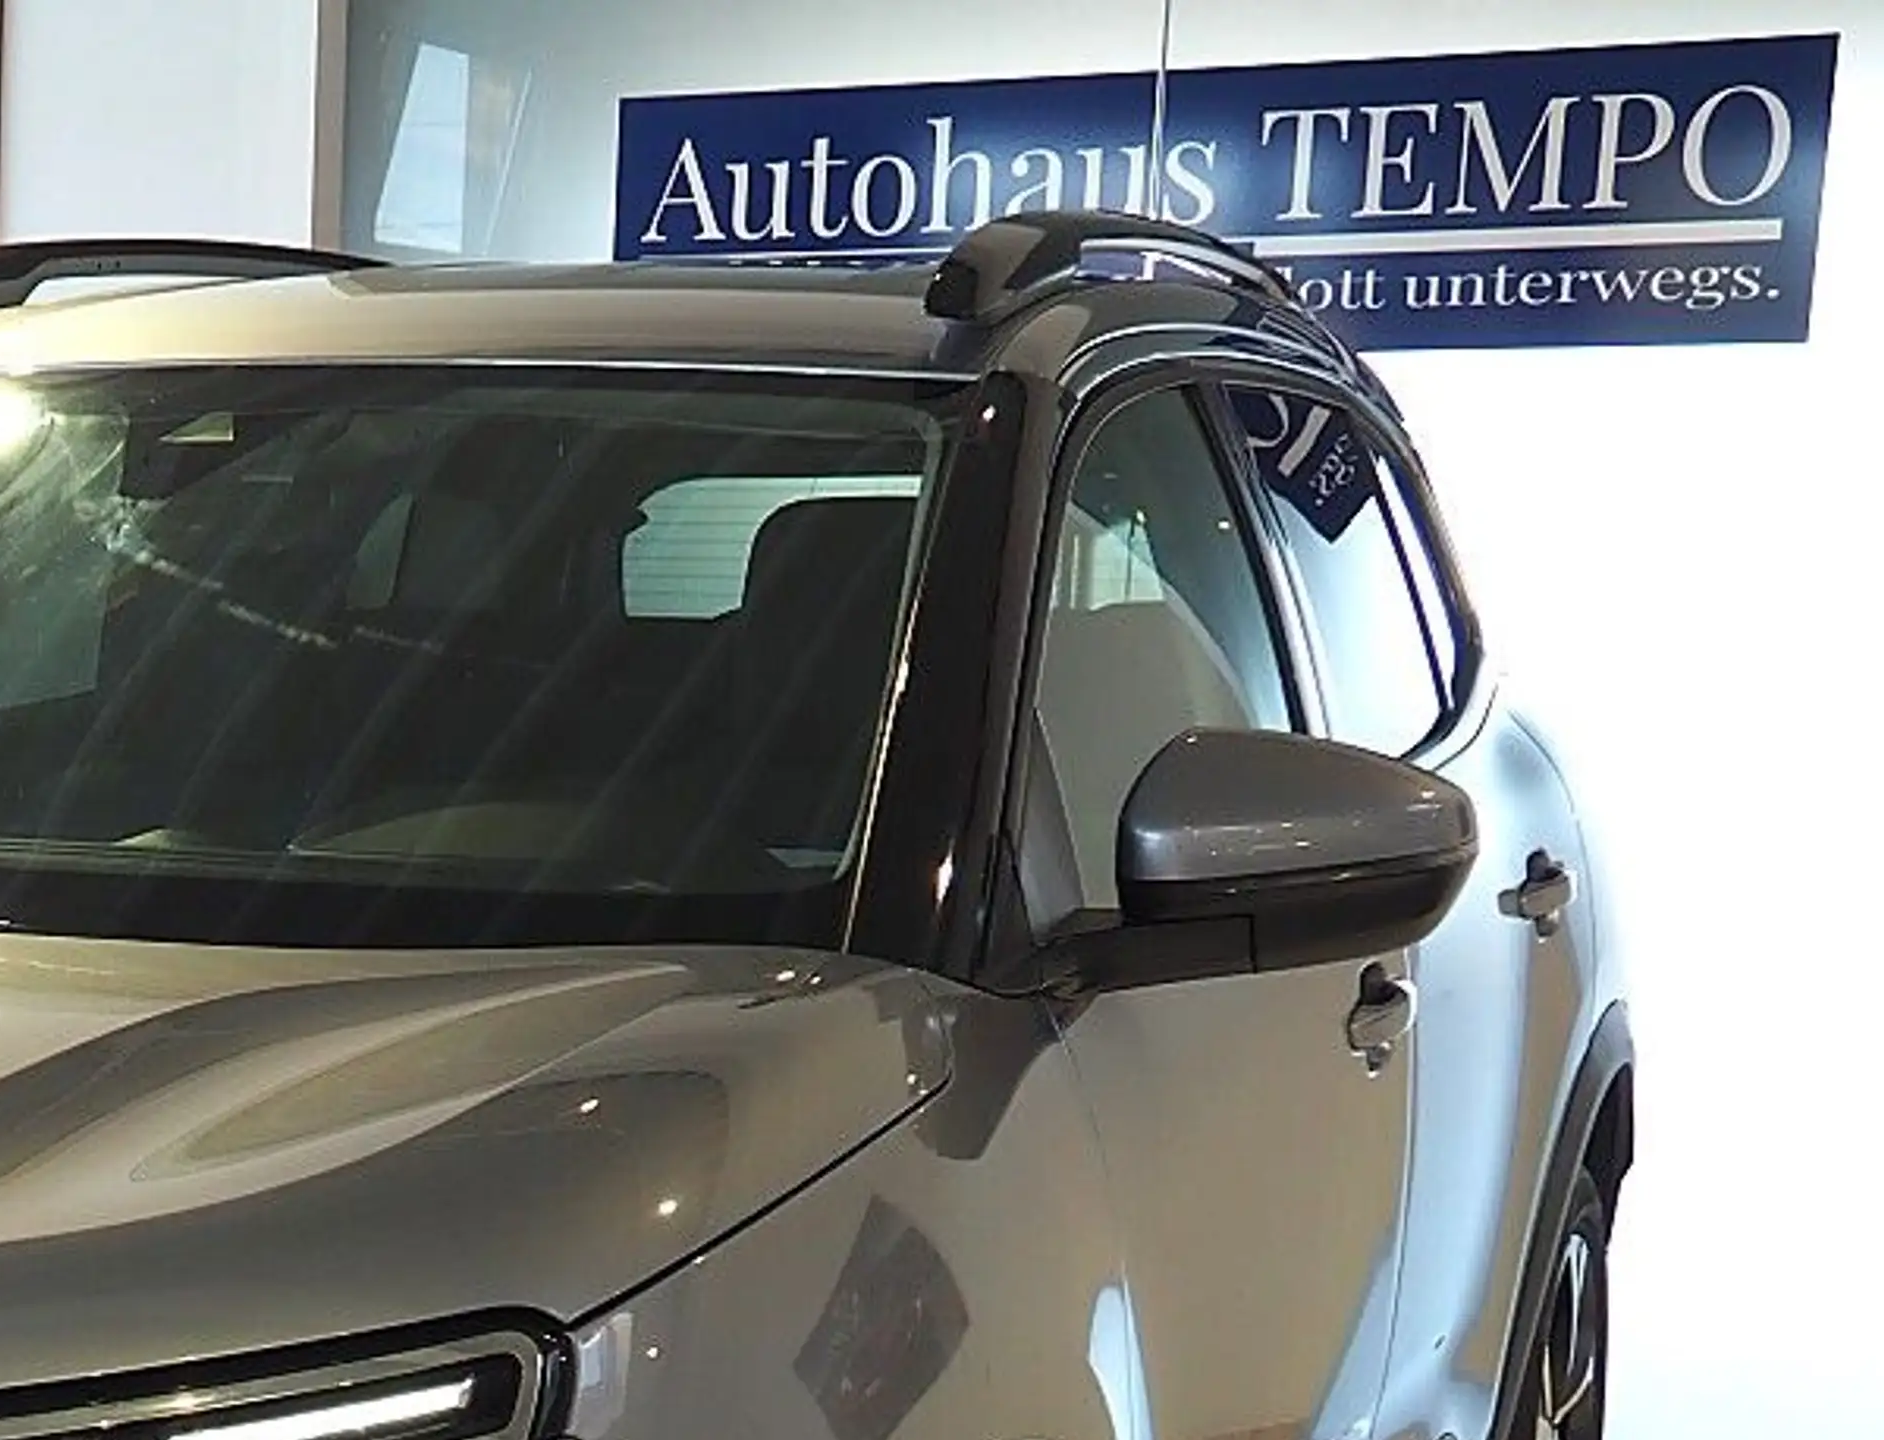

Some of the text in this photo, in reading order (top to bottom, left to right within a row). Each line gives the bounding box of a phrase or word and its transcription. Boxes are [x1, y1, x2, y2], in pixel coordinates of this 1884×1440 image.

[640, 84, 1793, 243] Autohaus TEMPO
[1405, 260, 1780, 311] unterwegs.
